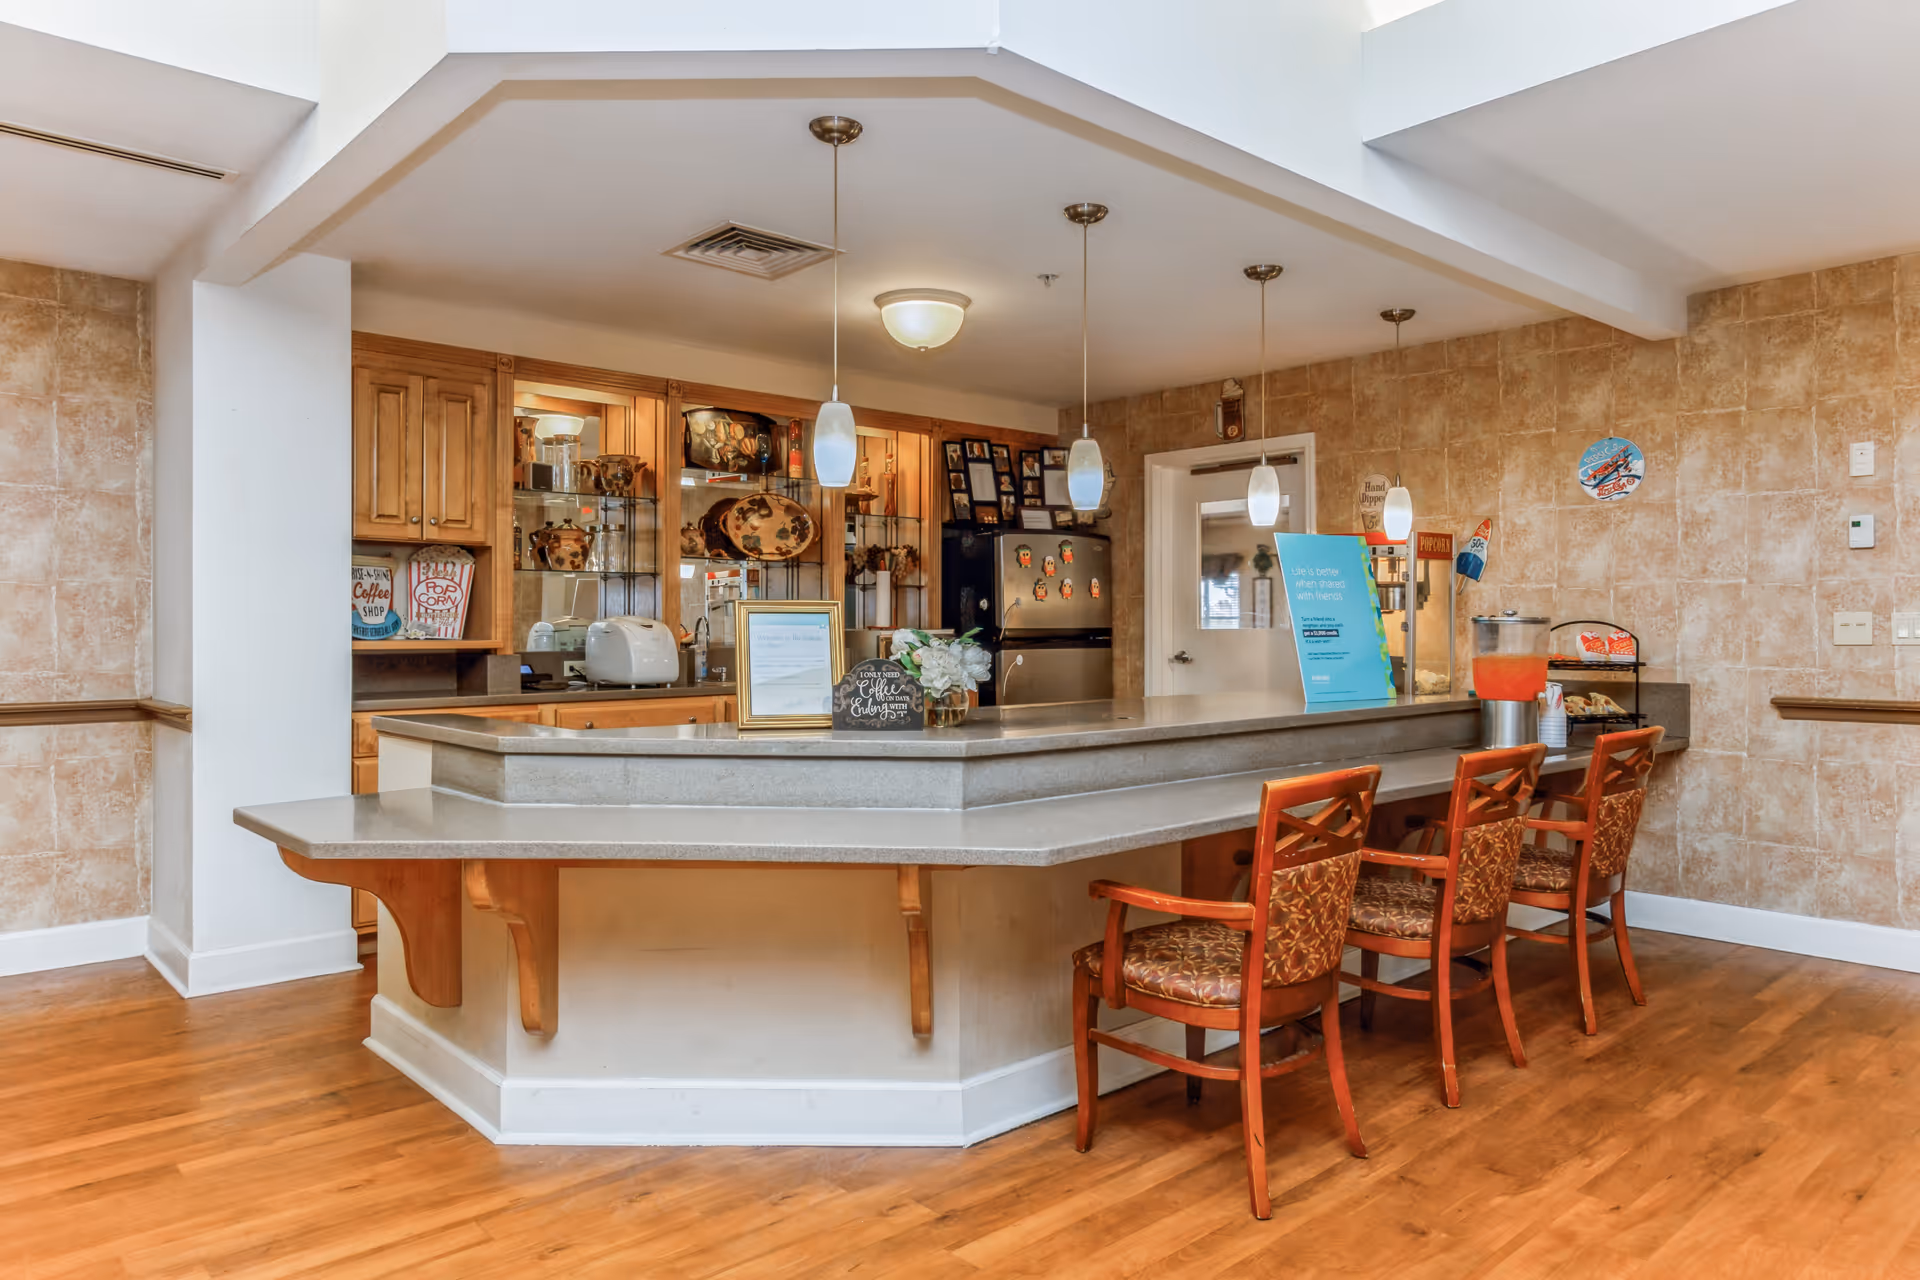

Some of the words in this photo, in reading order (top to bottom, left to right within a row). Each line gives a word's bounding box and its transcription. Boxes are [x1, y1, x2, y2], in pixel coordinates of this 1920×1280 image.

[1364, 481, 1386, 492] Hand
[1361, 493, 1387, 506] Dippe
[1420, 536, 1451, 553] POPCORN
[1316, 567, 1339, 577] better
[425, 581, 458, 596] POP
[1295, 579, 1317, 588] when
[1318, 579, 1346, 589] shared
[353, 581, 390, 604] Coffee
[417, 592, 457, 607] CORN
[1296, 591, 1314, 601] with
[1316, 591, 1343, 601] friends
[362, 606, 385, 617] SHOP
[856, 677, 906, 701] Coffee
[850, 697, 897, 720] Ending
